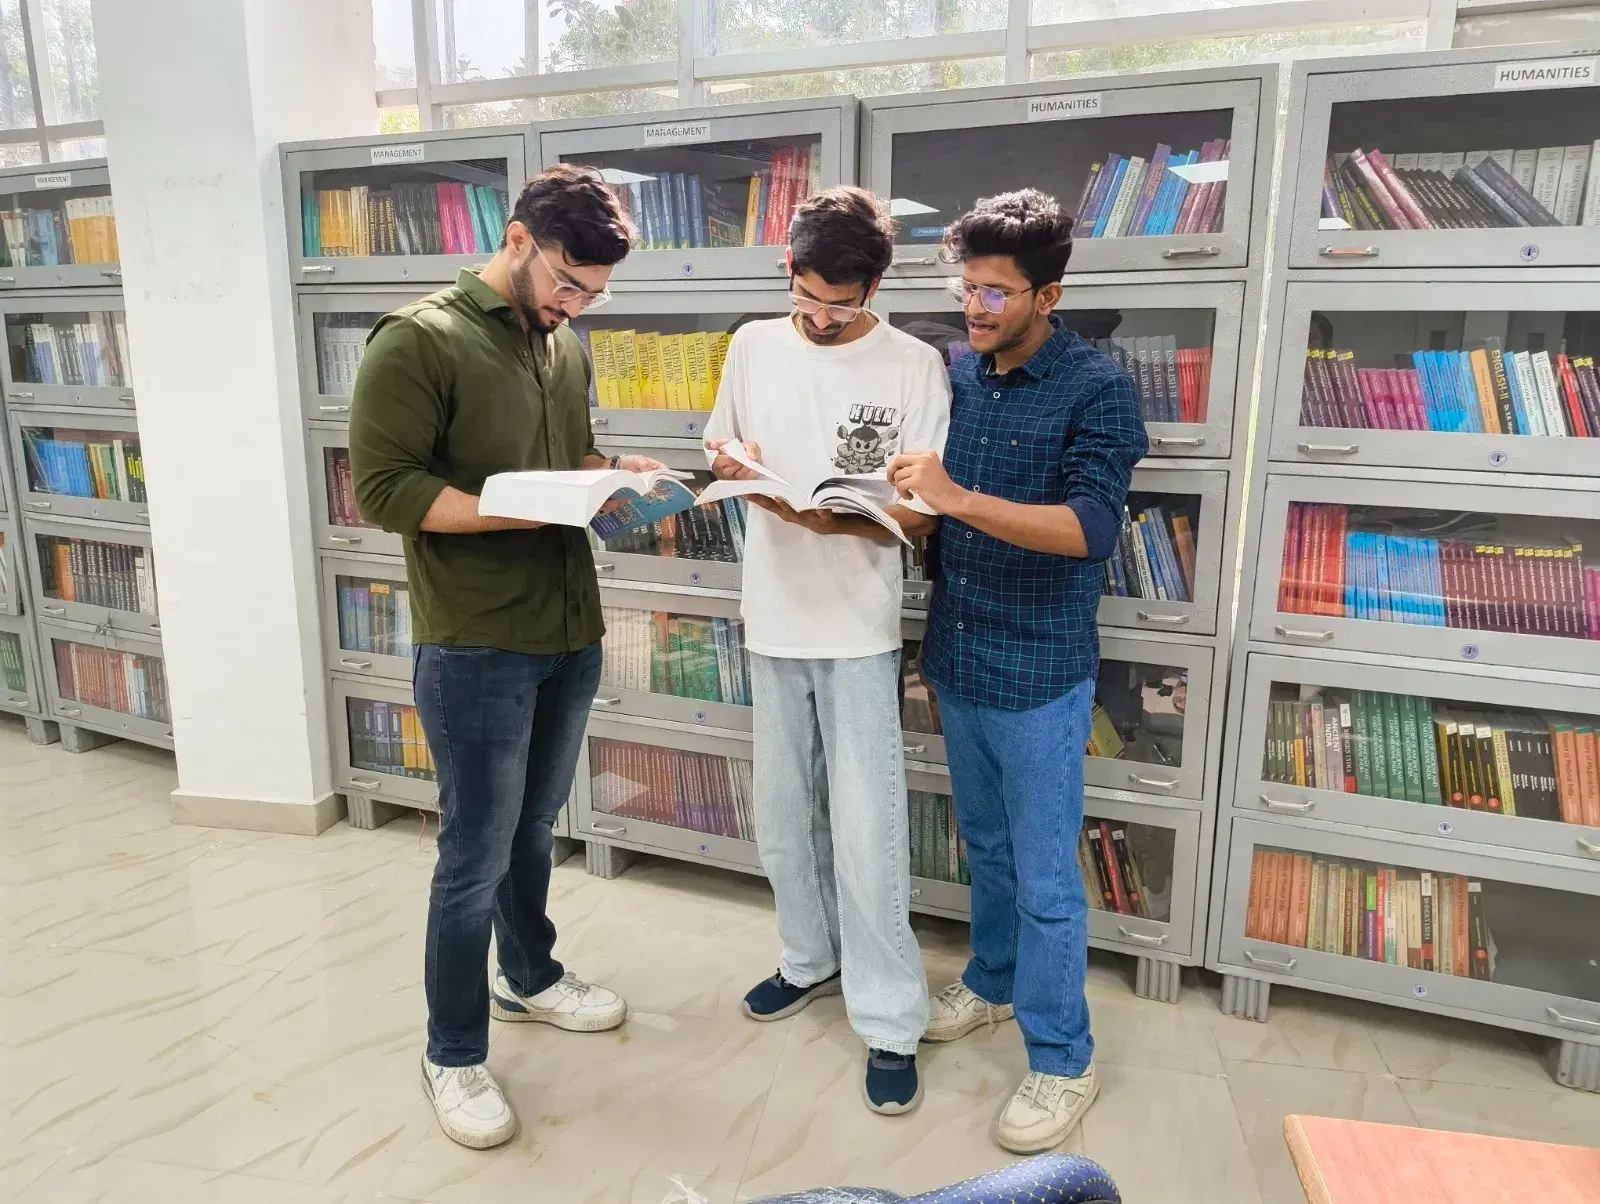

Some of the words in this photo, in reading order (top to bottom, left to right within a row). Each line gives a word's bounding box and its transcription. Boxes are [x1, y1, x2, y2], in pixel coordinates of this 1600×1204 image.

[1500, 66, 1591, 82] HUMANITIES
[1031, 99, 1098, 113] HUMANITIES
[646, 126, 707, 138] MANAGEMENT
[373, 148, 421, 158] MANAGEMENT
[36, 175, 69, 183] MANAGEMENT
[594, 342, 606, 378] METHODS
[603, 335, 616, 383] STATISTICAL
[615, 343, 628, 379] METHODS
[623, 336, 637, 383] STATISTICAL
[638, 344, 650, 379] METHODS
[647, 336, 660, 384] STATISTICAL
[662, 345, 674, 383] METHODS
[671, 338, 683, 386] STATISTICAL
[686, 345, 698, 382] METHODS
[695, 337, 707, 386] STATISTICAL
[708, 342, 720, 380] METHODS
[1139, 350, 1150, 397] ENGLISH-II
[1152, 350, 1163, 397] ENGLISH-II
[1166, 350, 1177, 398] ENGLISH-II
[1492, 349, 1509, 400] ENGLISH-II
[849, 404, 896, 426] HULK
[1331, 717, 1339, 753] ANCIENT
